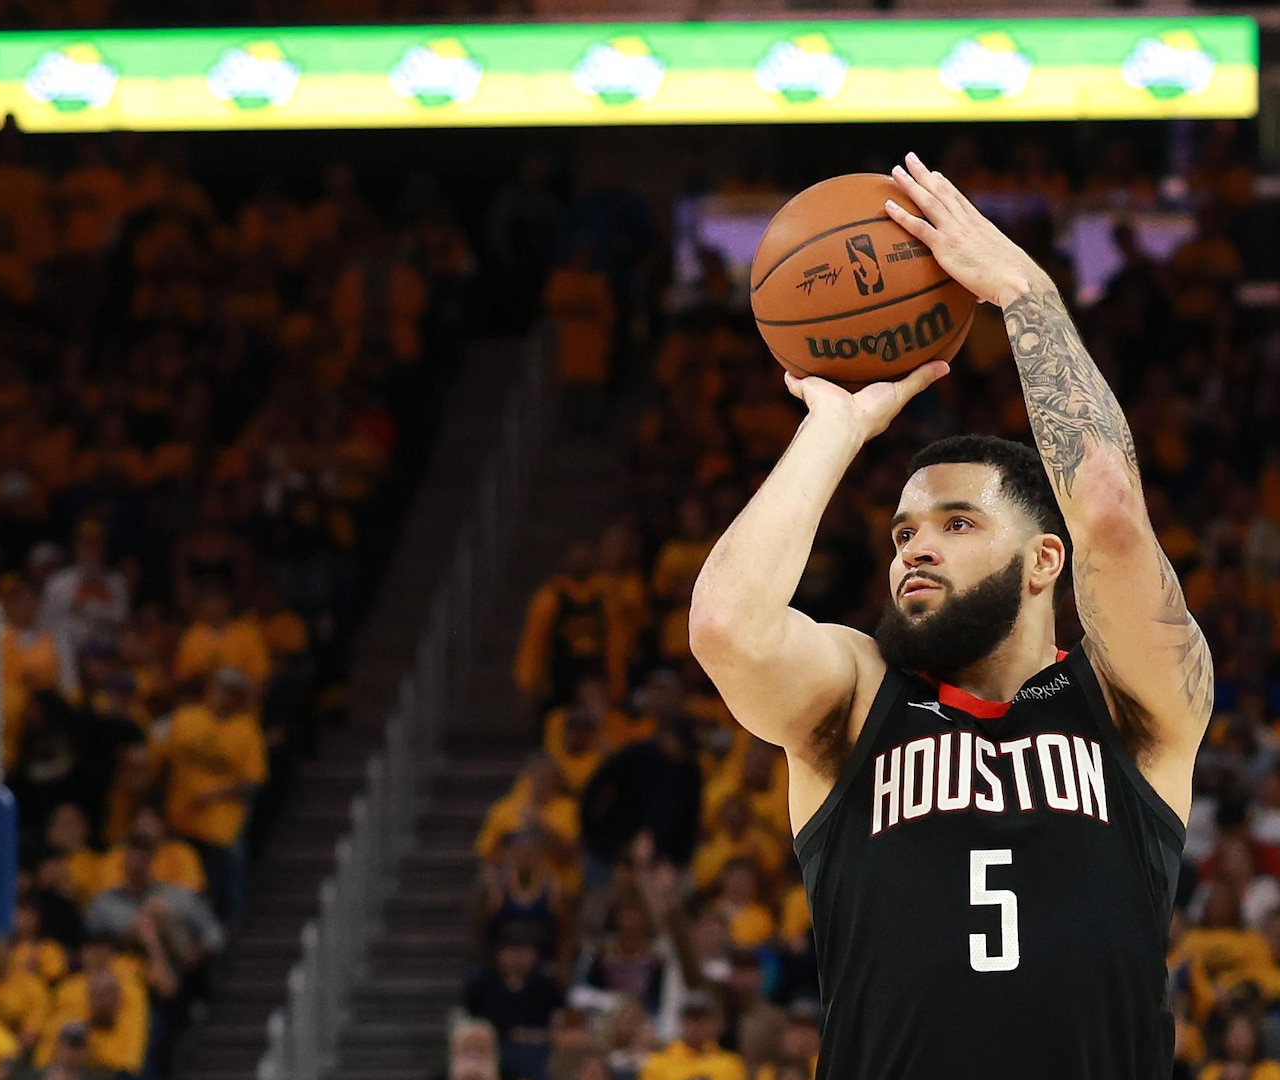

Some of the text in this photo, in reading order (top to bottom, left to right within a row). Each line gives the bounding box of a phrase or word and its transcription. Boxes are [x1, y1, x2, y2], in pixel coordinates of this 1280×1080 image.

[804, 302, 955, 362] Wilson
[870, 730, 1111, 837] HOUSTON
[969, 848, 1020, 972] 5
